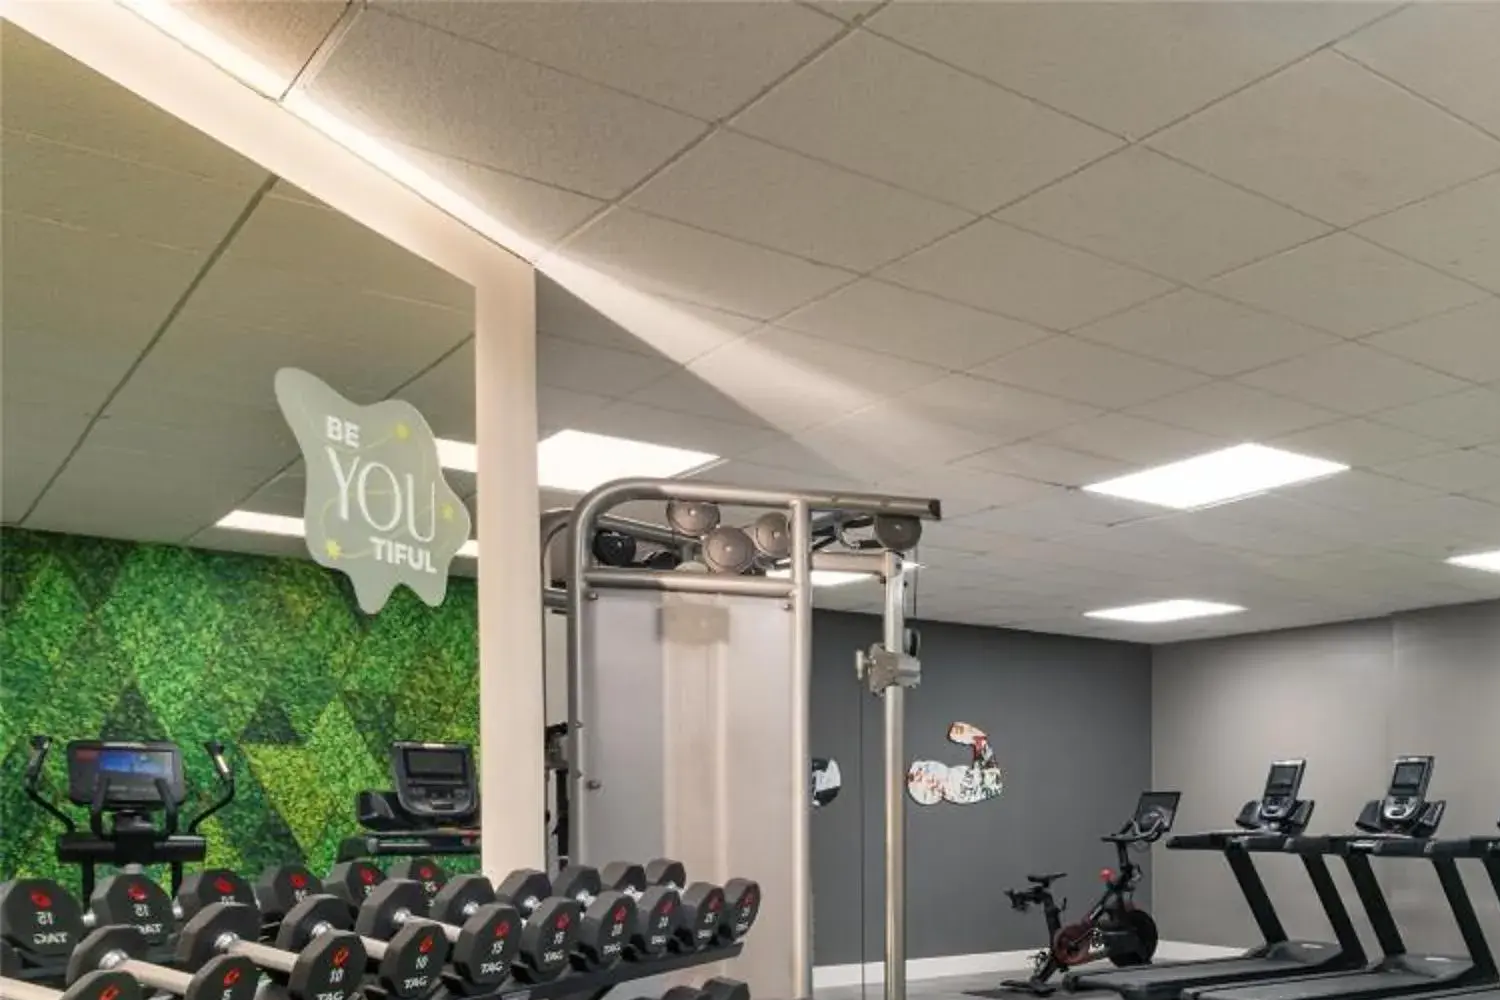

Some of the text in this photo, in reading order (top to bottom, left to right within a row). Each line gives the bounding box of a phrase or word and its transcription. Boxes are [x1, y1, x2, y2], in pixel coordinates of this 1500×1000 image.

[326, 415, 360, 449] BE
[325, 446, 437, 542] YOU
[368, 535, 438, 574] TIFUL
[491, 940, 505, 955] 15
[415, 955, 429, 970] 10
[329, 967, 345, 984] 10
[403, 975, 428, 990] TAG
